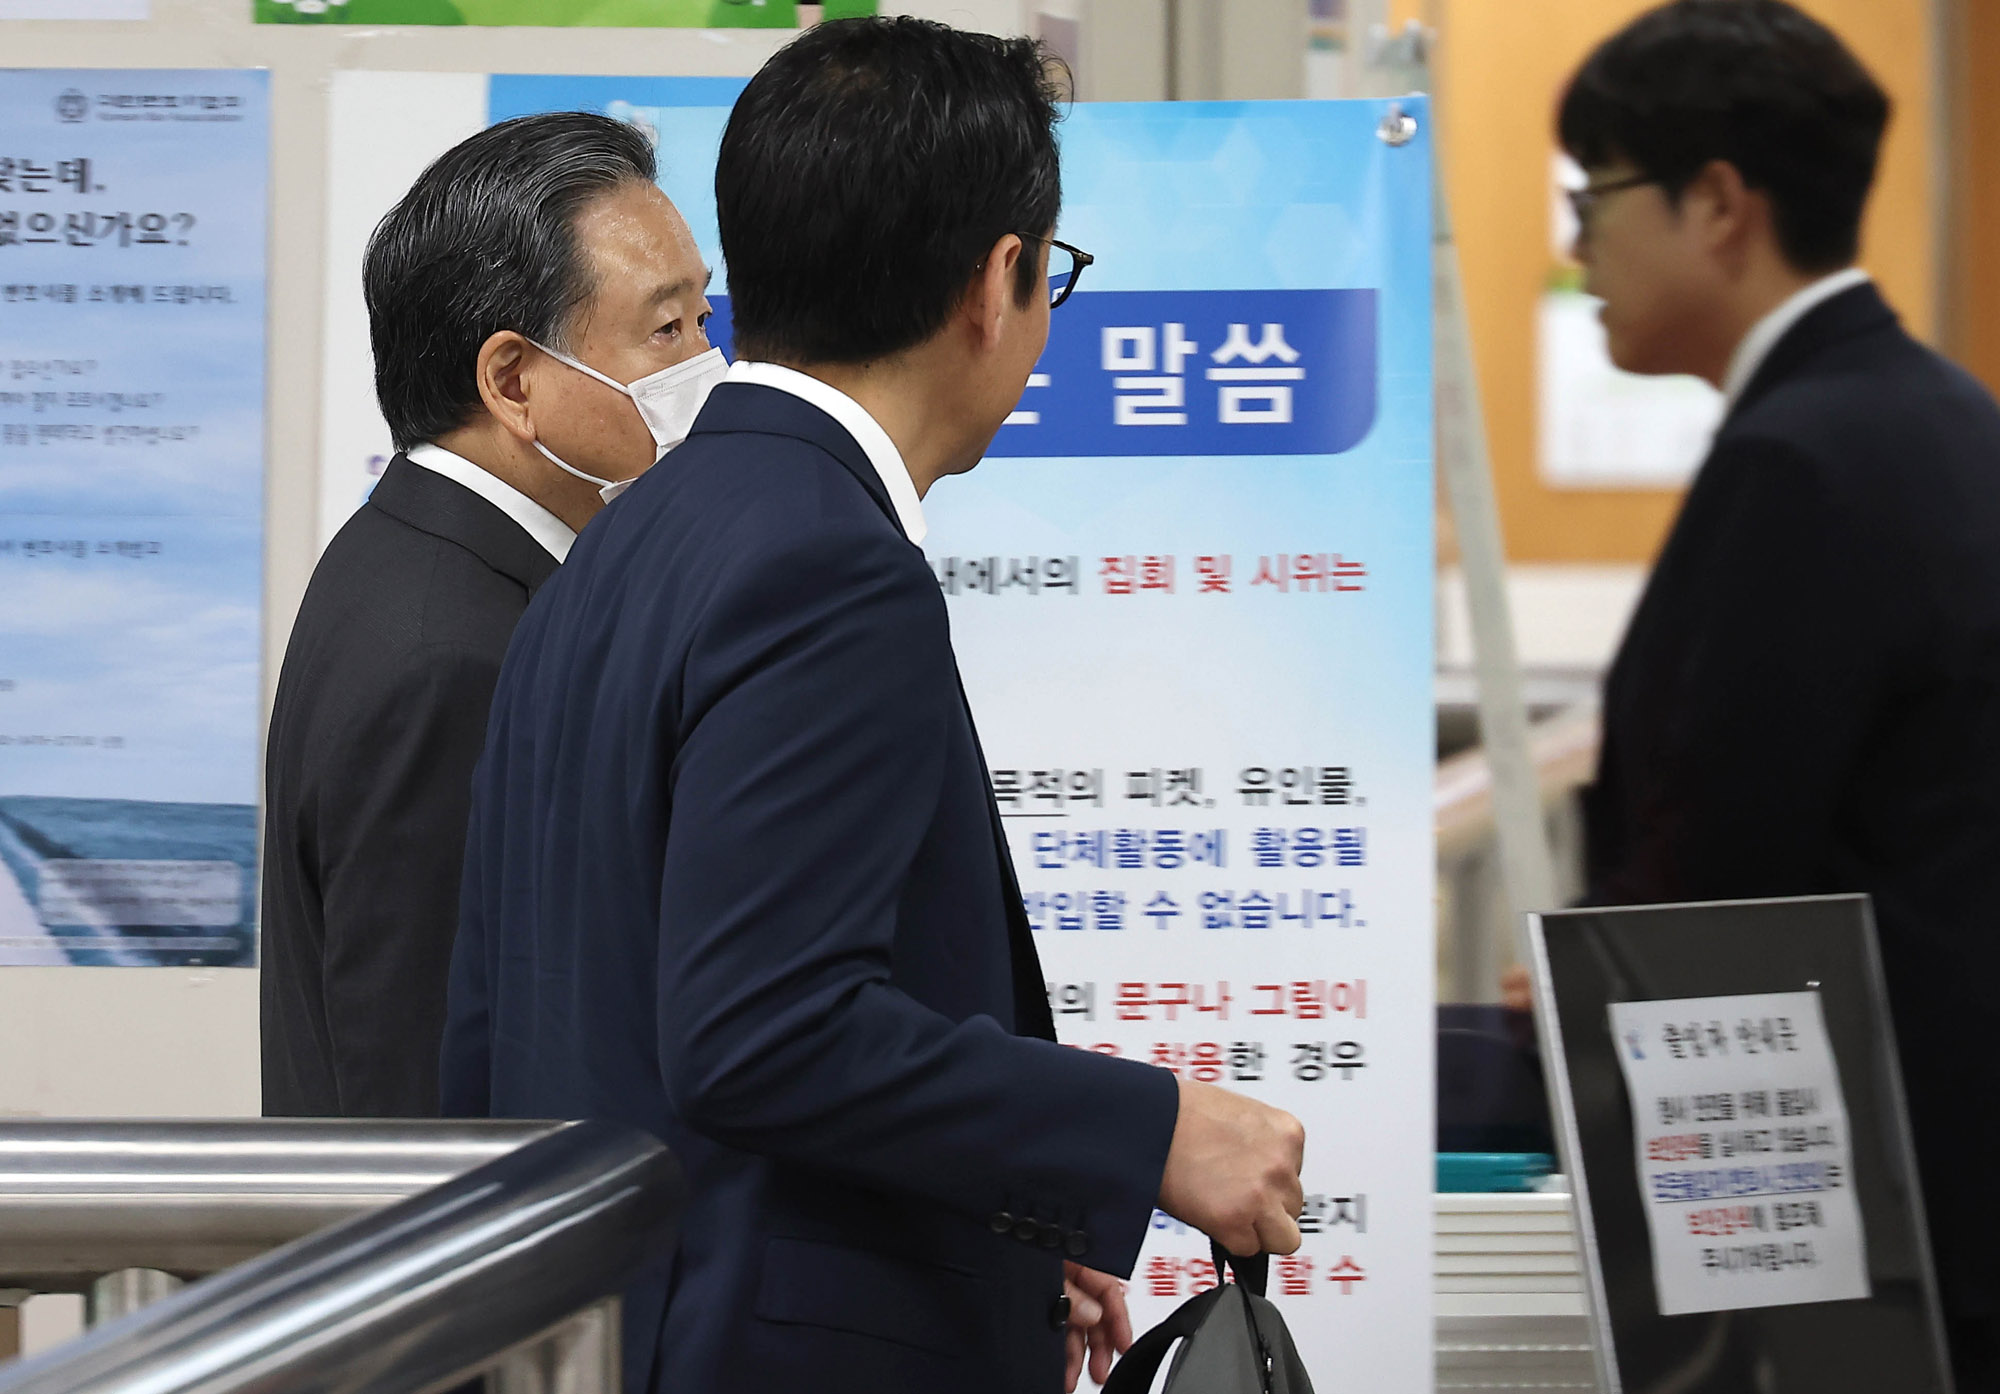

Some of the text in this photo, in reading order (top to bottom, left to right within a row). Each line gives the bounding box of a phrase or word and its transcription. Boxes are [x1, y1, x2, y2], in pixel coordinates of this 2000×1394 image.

[1101, 322, 1306, 425] 말씀
[1099, 554, 1176, 594] 집회
[1193, 554, 1231, 594] 및
[1251, 553, 1367, 592] 시위는
[1030, 827, 1368, 869] 단체활동에 활용될
[1141, 890, 1182, 931] 수
[1197, 889, 1367, 929] 없습니다.
[1112, 981, 1233, 1021] 문구나
[1248, 979, 1367, 1019] 그림이
[1289, 1041, 1367, 1082] 경우
[1327, 1255, 1367, 1295] 수
